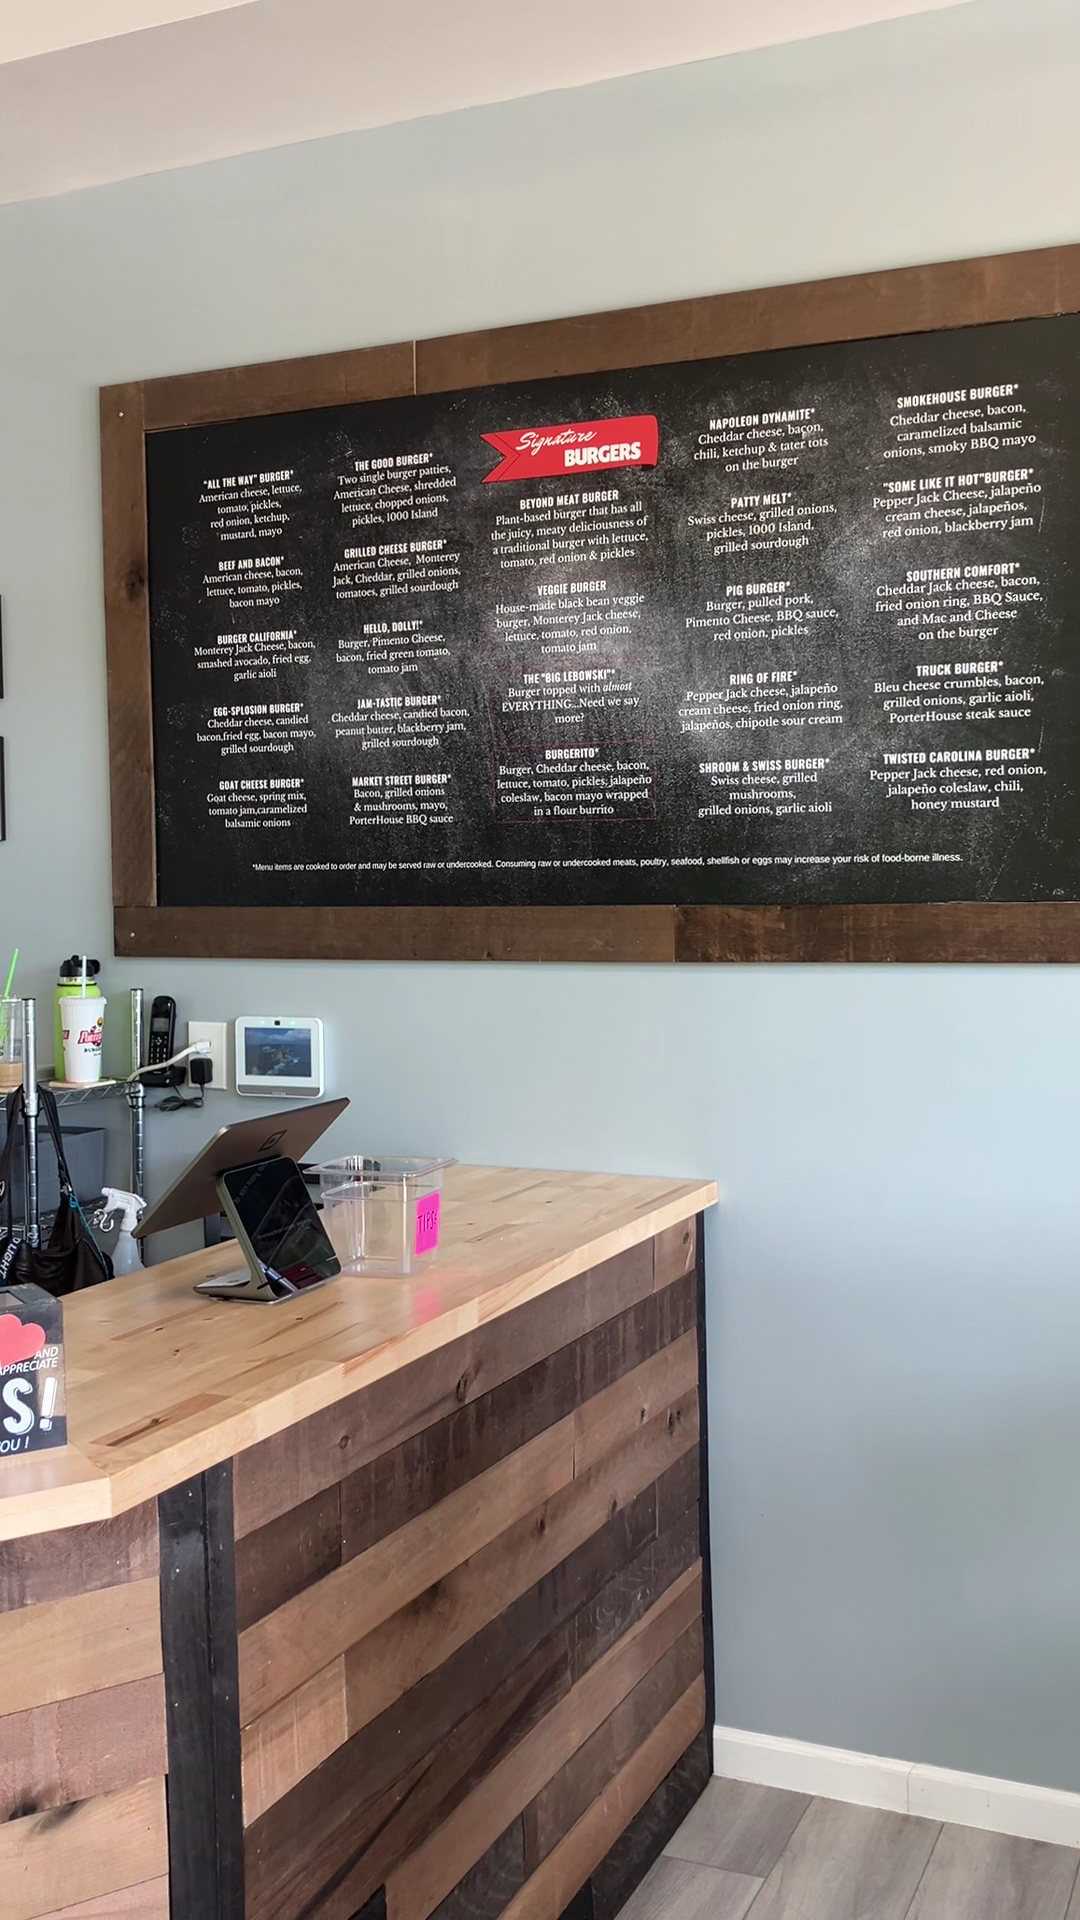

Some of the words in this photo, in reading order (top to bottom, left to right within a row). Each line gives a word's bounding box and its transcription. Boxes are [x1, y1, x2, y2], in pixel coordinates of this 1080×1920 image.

[897, 390, 966, 408] SMOKEHOUSE
[709, 414, 758, 430] NAPOLEON
[897, 422, 966, 441] caramelized
[969, 418, 1022, 433] balsamic
[698, 430, 744, 444] Cheddar
[746, 427, 784, 439] cheese,
[787, 424, 824, 435] bacon,
[515, 429, 597, 456] Signature
[564, 442, 641, 467] BURGERS
[355, 460, 369, 471] THE
[370, 457, 393, 470] GOOD
[222, 477, 235, 488] THE
[333, 487, 376, 499] American
[377, 484, 412, 495] Cheese,
[413, 477, 456, 491] shredded
[199, 492, 238, 503] American
[239, 489, 270, 499] cheese,
[271, 486, 302, 496] lettuce,
[520, 496, 553, 510] BEYOND
[556, 494, 578, 506] MEAT
[581, 490, 619, 504] BURGER
[731, 495, 759, 508] PATTY
[217, 504, 249, 514] tomato,
[250, 500, 282, 514] pickles,
[885, 511, 921, 522] cream
[923, 506, 965, 519] cheese,
[968, 500, 1027, 519] jalapeños,
[344, 546, 376, 559] GRILLED
[378, 543, 407, 556] CHEESE
[713, 538, 748, 555] grilled
[750, 534, 809, 550] sourdough
[218, 560, 235, 571] BEEF
[237, 559, 253, 570] AND
[333, 560, 375, 572] American
[377, 557, 411, 568] Cheese,
[415, 554, 460, 565] Monterey
[202, 573, 242, 584] American
[243, 570, 273, 581] cheese,
[275, 568, 303, 578] bacon,
[906, 567, 960, 582] SOUTHERN
[537, 584, 567, 596] VEGGIE
[570, 581, 607, 594] BURGER
[726, 585, 743, 596] PIG
[496, 616, 530, 630] burger,
[532, 614, 580, 626] Monterey
[582, 609, 602, 624] Jack
[604, 608, 641, 620] cheese,
[363, 622, 389, 635] HELLO,
[217, 633, 247, 645] BURGER
[338, 639, 370, 651] Burger,
[372, 636, 409, 647] Pimento
[410, 633, 446, 644] Cheese,
[194, 646, 233, 657] Monterey
[235, 643, 252, 655] Jack
[254, 642, 286, 652] Cheese,
[287, 640, 316, 650] bacon,
[916, 664, 951, 676] TRUCK
[523, 673, 539, 684] THE
[730, 673, 753, 685] RING
[756, 672, 768, 684] OF
[357, 696, 402, 709] JAM-TASTIC
[213, 704, 267, 717] EGG-SPLOSION
[554, 712, 585, 723] more?
[221, 743, 247, 756] grilled
[248, 741, 294, 754] sourdough
[362, 737, 390, 751] grilled
[391, 735, 439, 749] sourdough
[883, 752, 926, 765] TWISTED
[929, 750, 982, 763] CAROLINA
[699, 761, 739, 773] SHROOM
[742, 761, 749, 772] &
[751, 760, 781, 771] SWISS
[219, 780, 238, 790] GOAT
[240, 779, 267, 790] CHEESE
[352, 775, 382, 787] MARKET
[384, 775, 412, 786] STREET
[497, 777, 530, 789] lettuce,
[532, 777, 569, 788] tomato,
[571, 774, 607, 789] pickles,
[609, 772, 652, 788] jalapeño
[729, 787, 797, 800] mushrooms,
[911, 797, 947, 813] honey
[950, 795, 1000, 809] mustard
[225, 818, 260, 828] balsamic
[262, 818, 291, 827] onions
[349, 814, 403, 824] PorterHouse
[405, 814, 427, 826] BBQ
[428, 815, 454, 823] sauce
[275, 862, 292, 871] items
[305, 862, 329, 870] cooked
[339, 861, 357, 870] order
[358, 861, 371, 870] and
[372, 863, 387, 871] may
[399, 860, 421, 869] served
[446, 859, 494, 868] undercooked.
[495, 859, 536, 870] Consuming
[562, 858, 611, 867] undercooked
[612, 858, 639, 867] meats,
[640, 857, 669, 868] poultry,
[670, 857, 704, 866] seafood,
[706, 856, 739, 865] shellfish
[752, 858, 772, 866] eggs
[774, 858, 792, 866] may
[794, 855, 830, 864] increase
[832, 857, 851, 865] your
[853, 855, 870, 863] risk
[882, 854, 930, 863] food-borne
[931, 853, 963, 862] illness.
[34, 1346, 59, 1360] AND
[0, 1437, 21, 1453] OU
